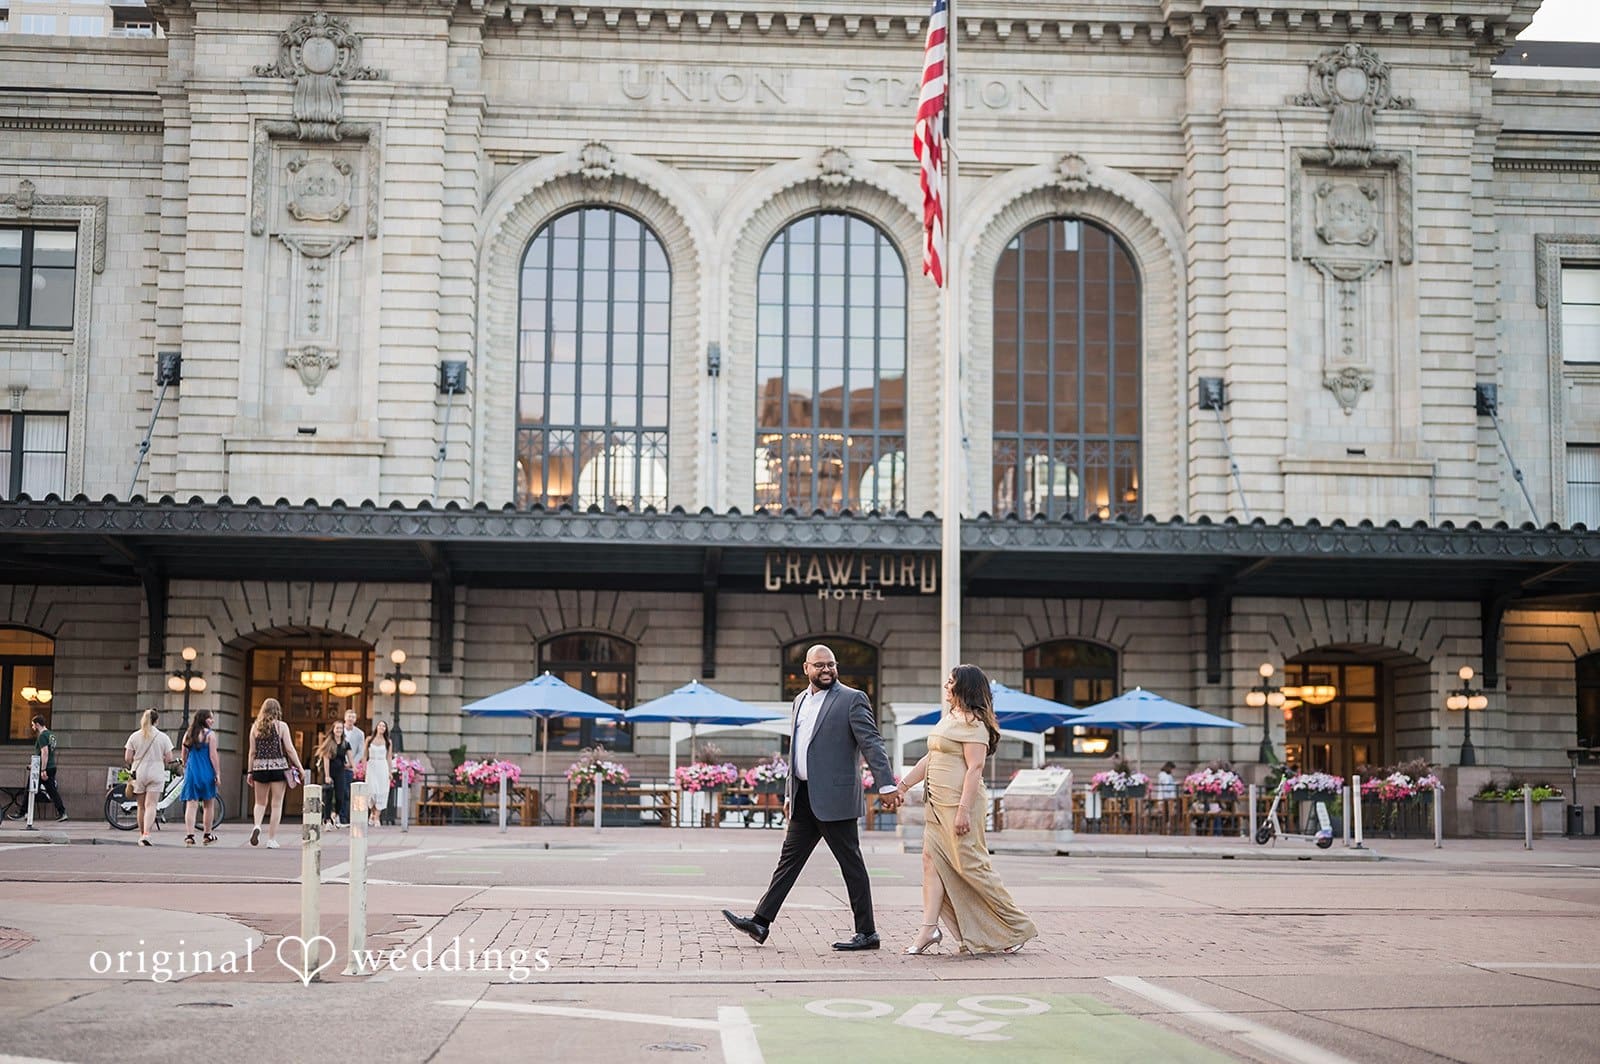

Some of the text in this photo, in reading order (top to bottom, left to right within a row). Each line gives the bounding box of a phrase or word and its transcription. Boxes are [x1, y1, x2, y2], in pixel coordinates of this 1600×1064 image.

[618, 70, 1055, 111] UNION STAION
[765, 551, 937, 594] CRAWFORD
[818, 588, 886, 602] HOTEL
